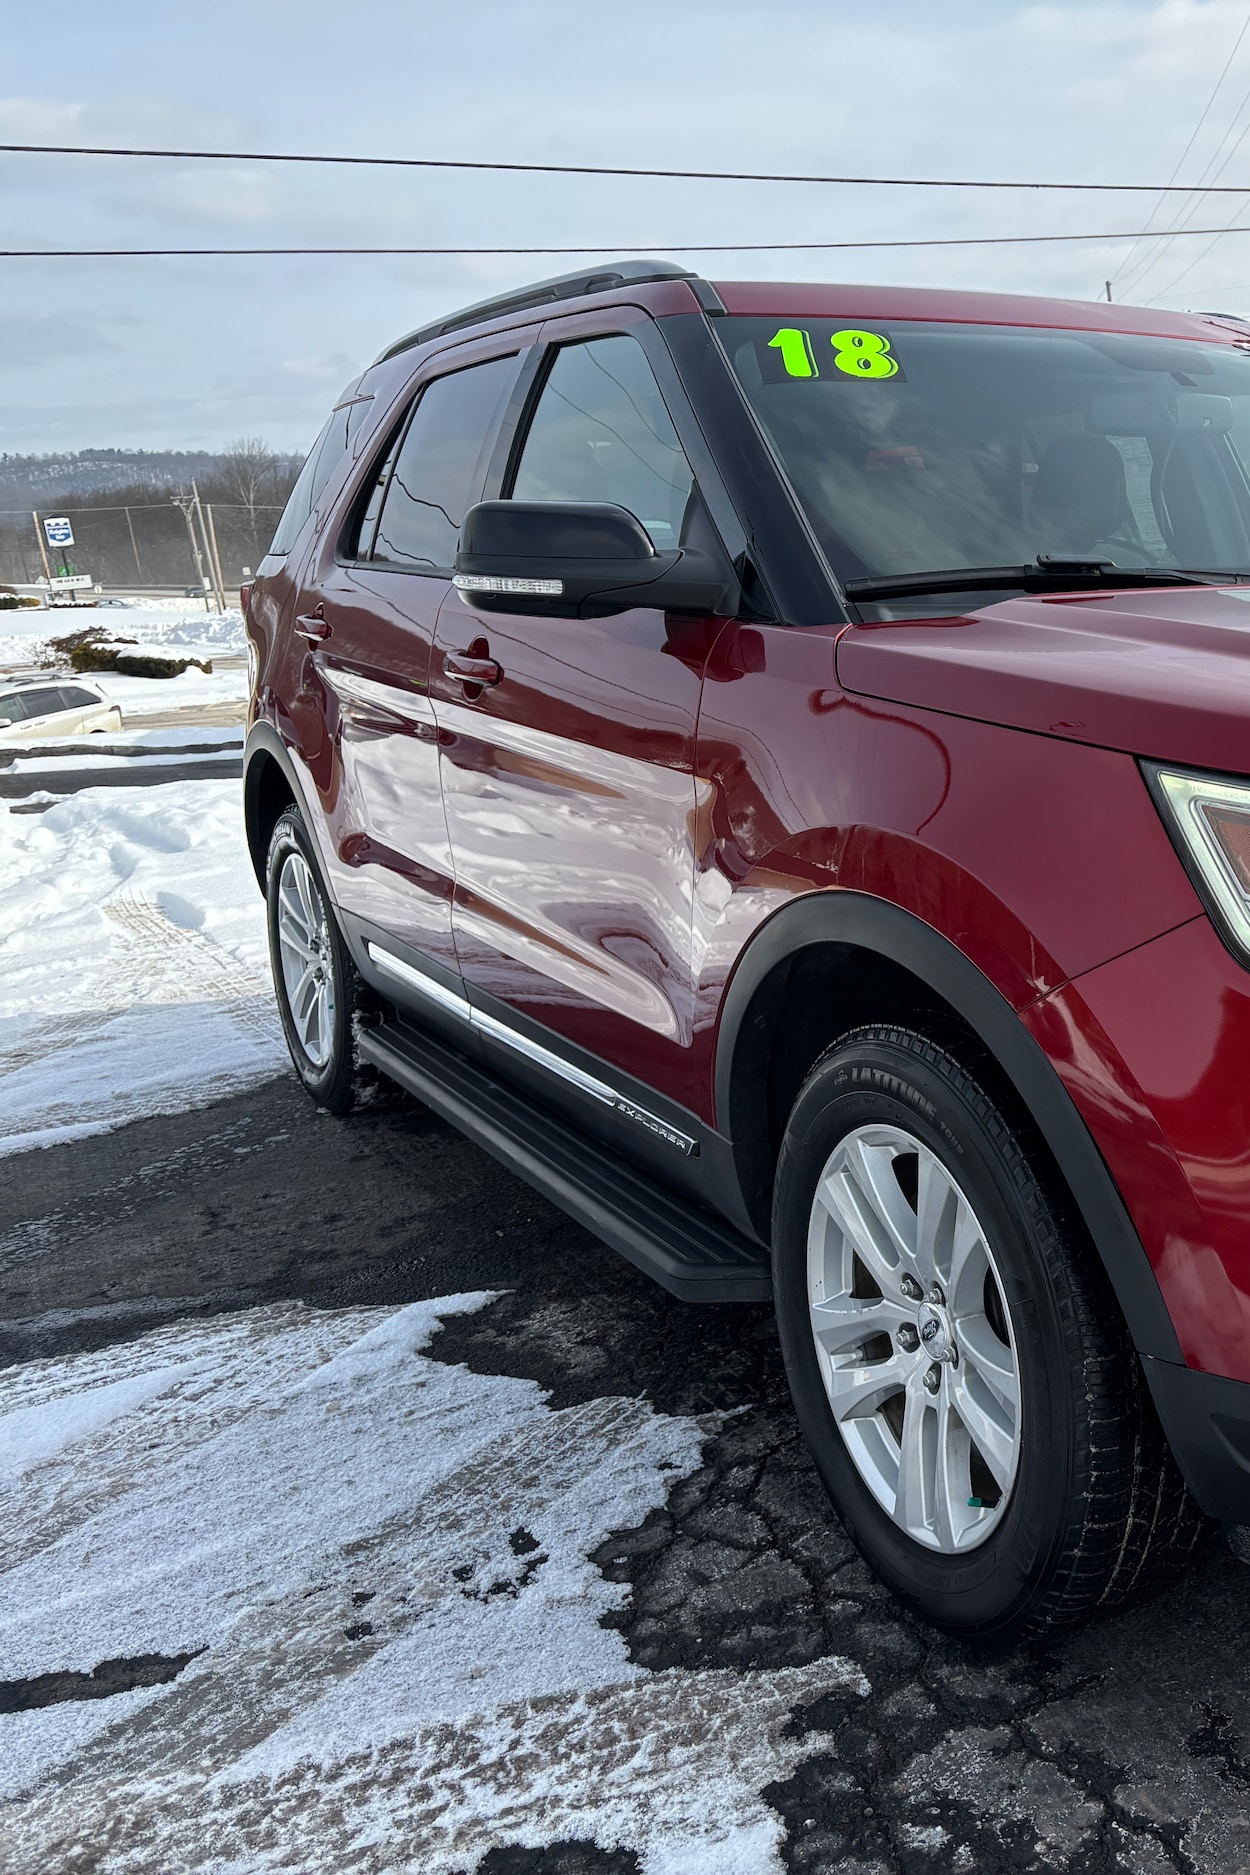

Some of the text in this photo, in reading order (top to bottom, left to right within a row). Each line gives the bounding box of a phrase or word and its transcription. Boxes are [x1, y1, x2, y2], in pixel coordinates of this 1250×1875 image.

[767, 328, 899, 378] 18
[617, 1102, 686, 1150] EXPLORER
[851, 1067, 965, 1155] LATITUDE TOUR
